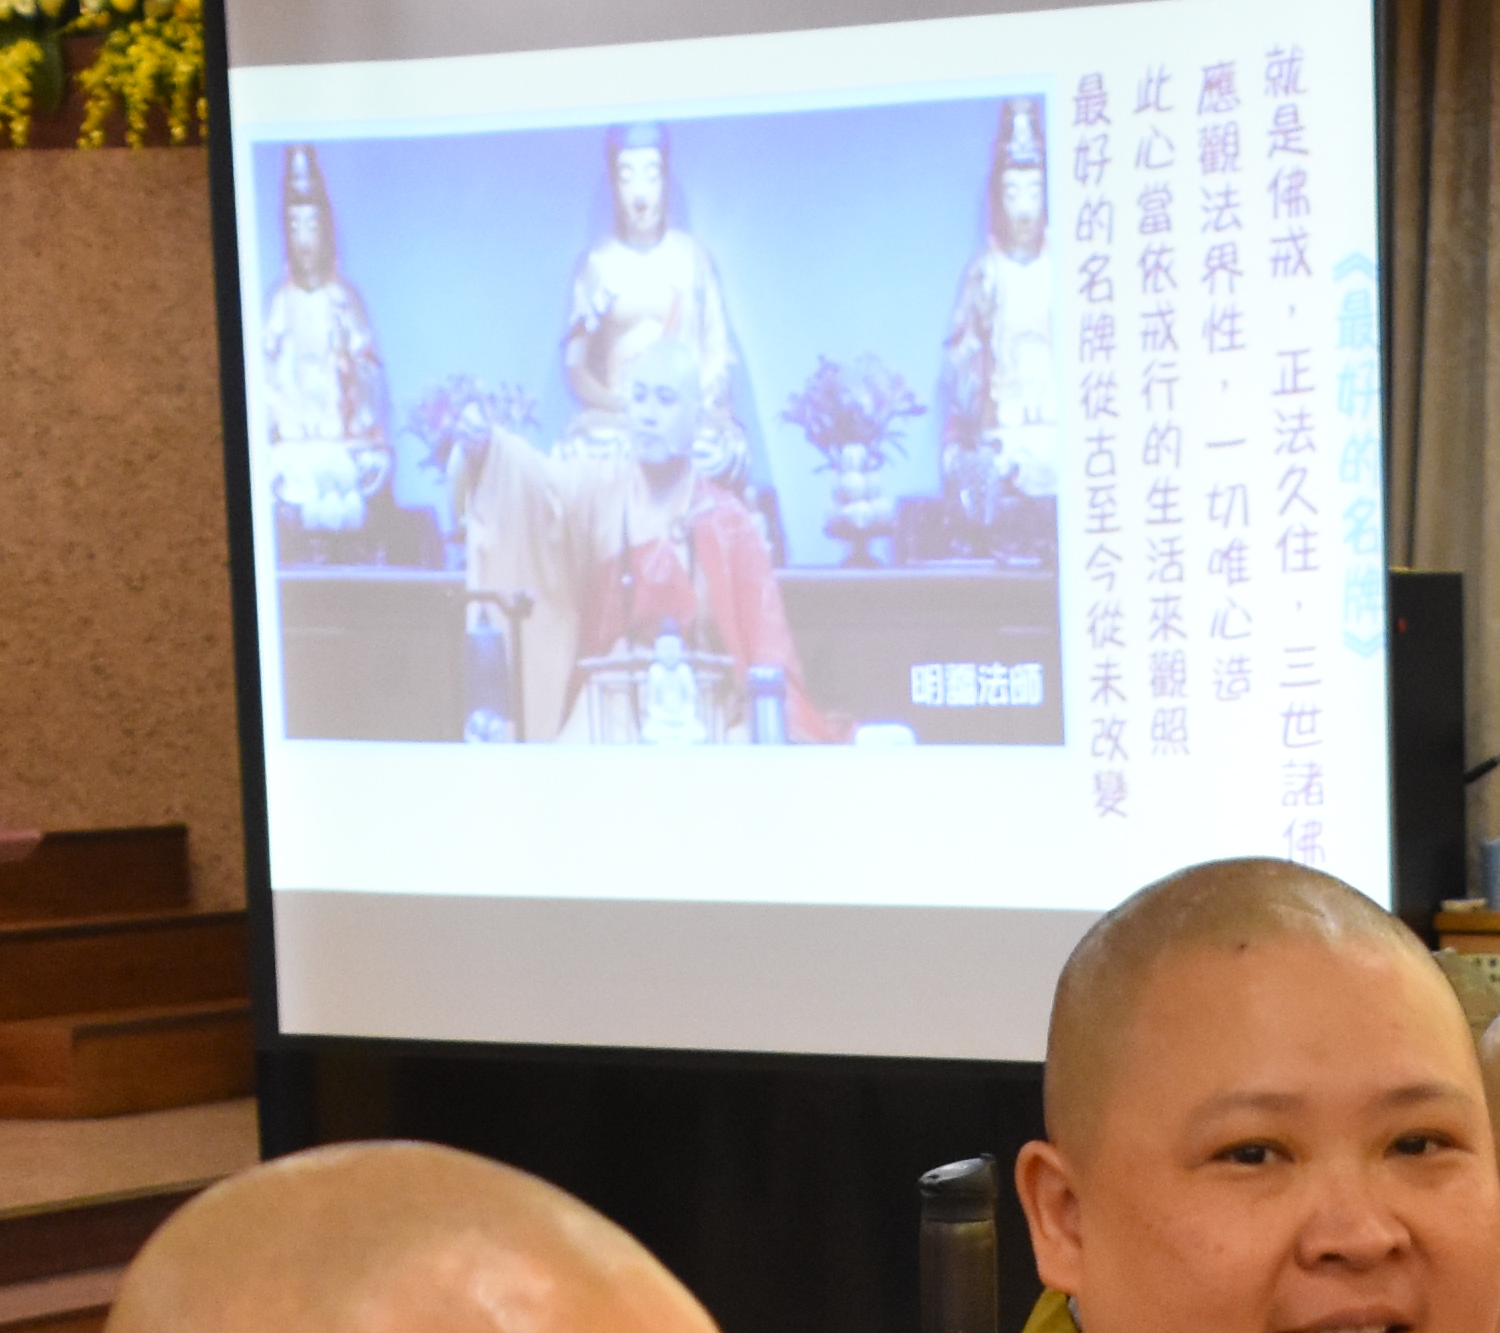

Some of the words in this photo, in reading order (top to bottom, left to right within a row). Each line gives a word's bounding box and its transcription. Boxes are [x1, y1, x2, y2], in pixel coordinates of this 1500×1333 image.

[1070, 71, 1130, 820] 最好的名牌從古至今從未改變
[1132, 61, 1191, 757] 此心當依戒行的生活來觀照
[1196, 59, 1253, 702] 應觀法界性，一切唯心造
